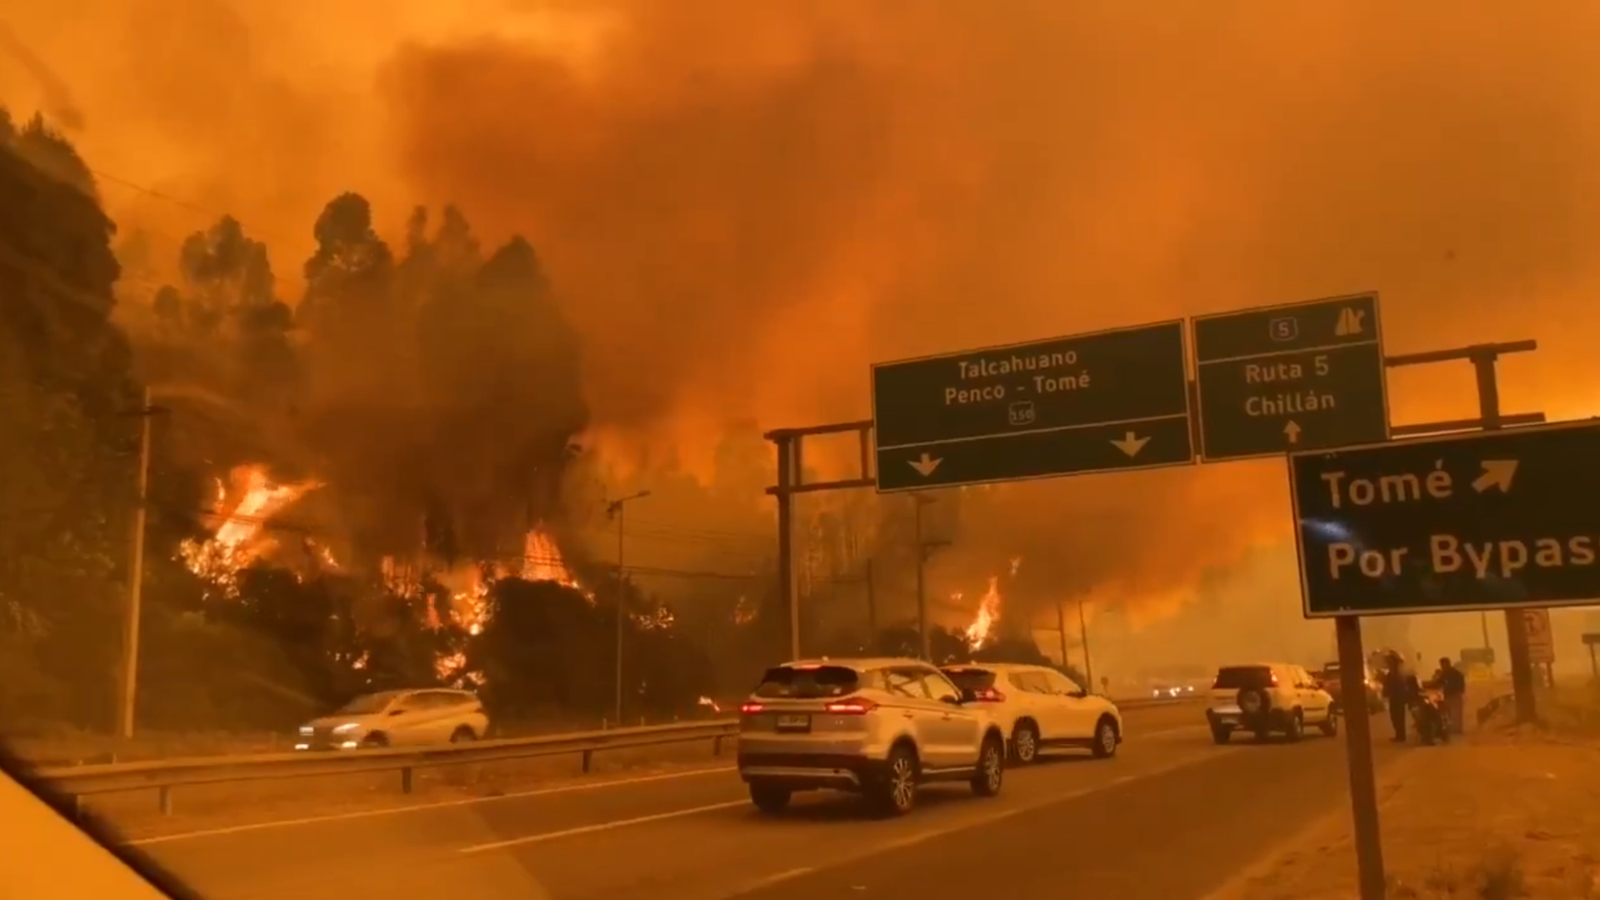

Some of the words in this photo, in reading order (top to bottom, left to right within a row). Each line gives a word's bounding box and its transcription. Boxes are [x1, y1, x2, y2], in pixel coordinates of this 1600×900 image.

[1278, 321, 1290, 337] 5
[958, 350, 1078, 379] Talcahuano
[1245, 363, 1302, 383] Ruta
[1314, 355, 1329, 376] 5
[945, 384, 1006, 405] Penco
[1033, 369, 1091, 394] Tomé
[1011, 408, 1034, 422] 150
[1245, 389, 1335, 416] Chillán
[1320, 457, 1454, 509] Tomé
[1328, 541, 1409, 580] Por
[1430, 533, 1600, 579] Bypas
